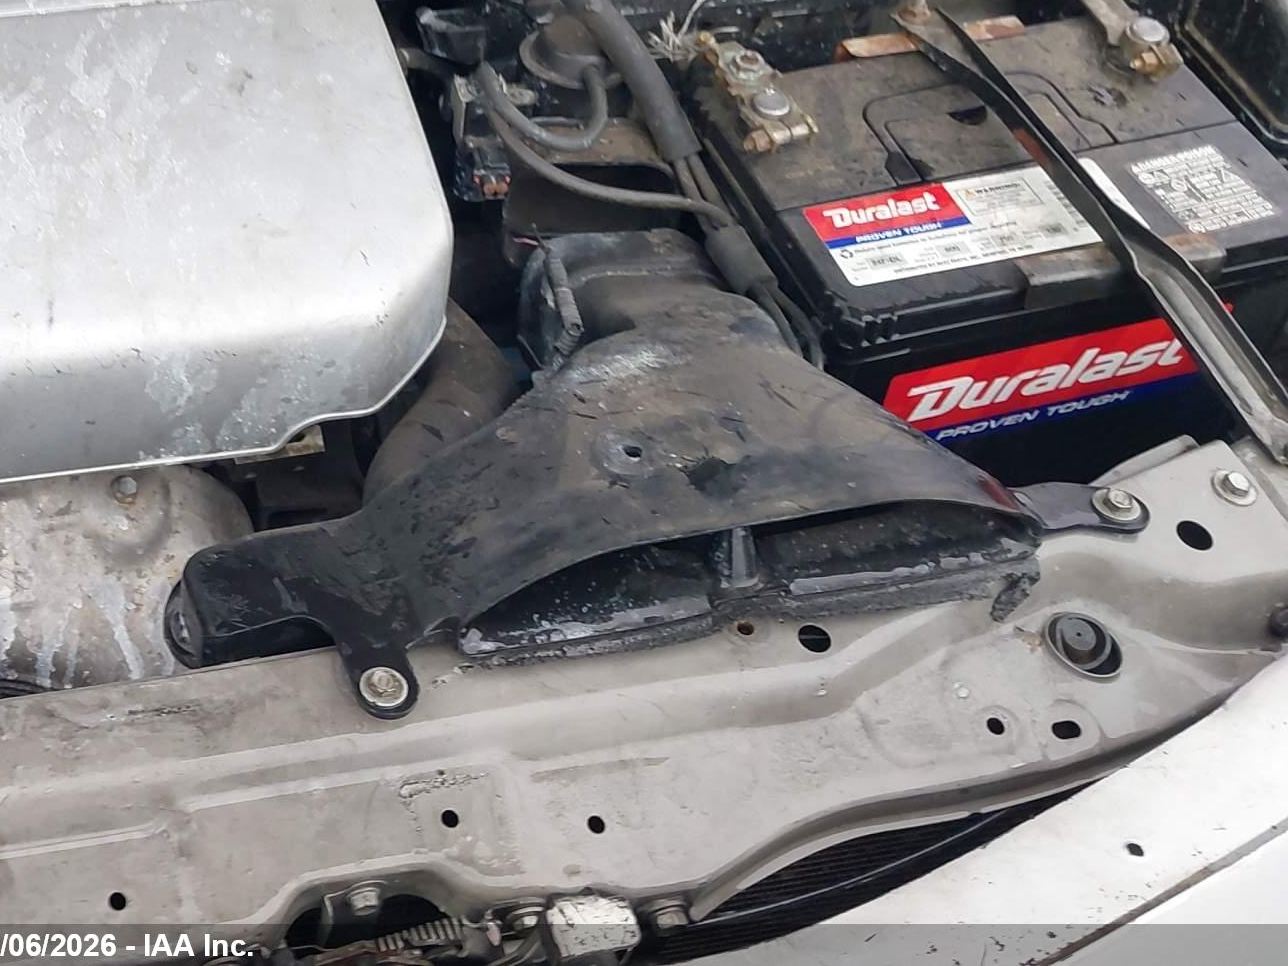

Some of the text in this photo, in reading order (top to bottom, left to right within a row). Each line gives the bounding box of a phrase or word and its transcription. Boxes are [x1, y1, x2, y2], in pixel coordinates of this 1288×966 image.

[822, 191, 941, 228] Duralast
[855, 229, 902, 243] PROVEN
[904, 222, 942, 236] TOUGH
[906, 337, 1184, 422] Duralast
[935, 390, 1131, 441] PROVEN TOUGH
